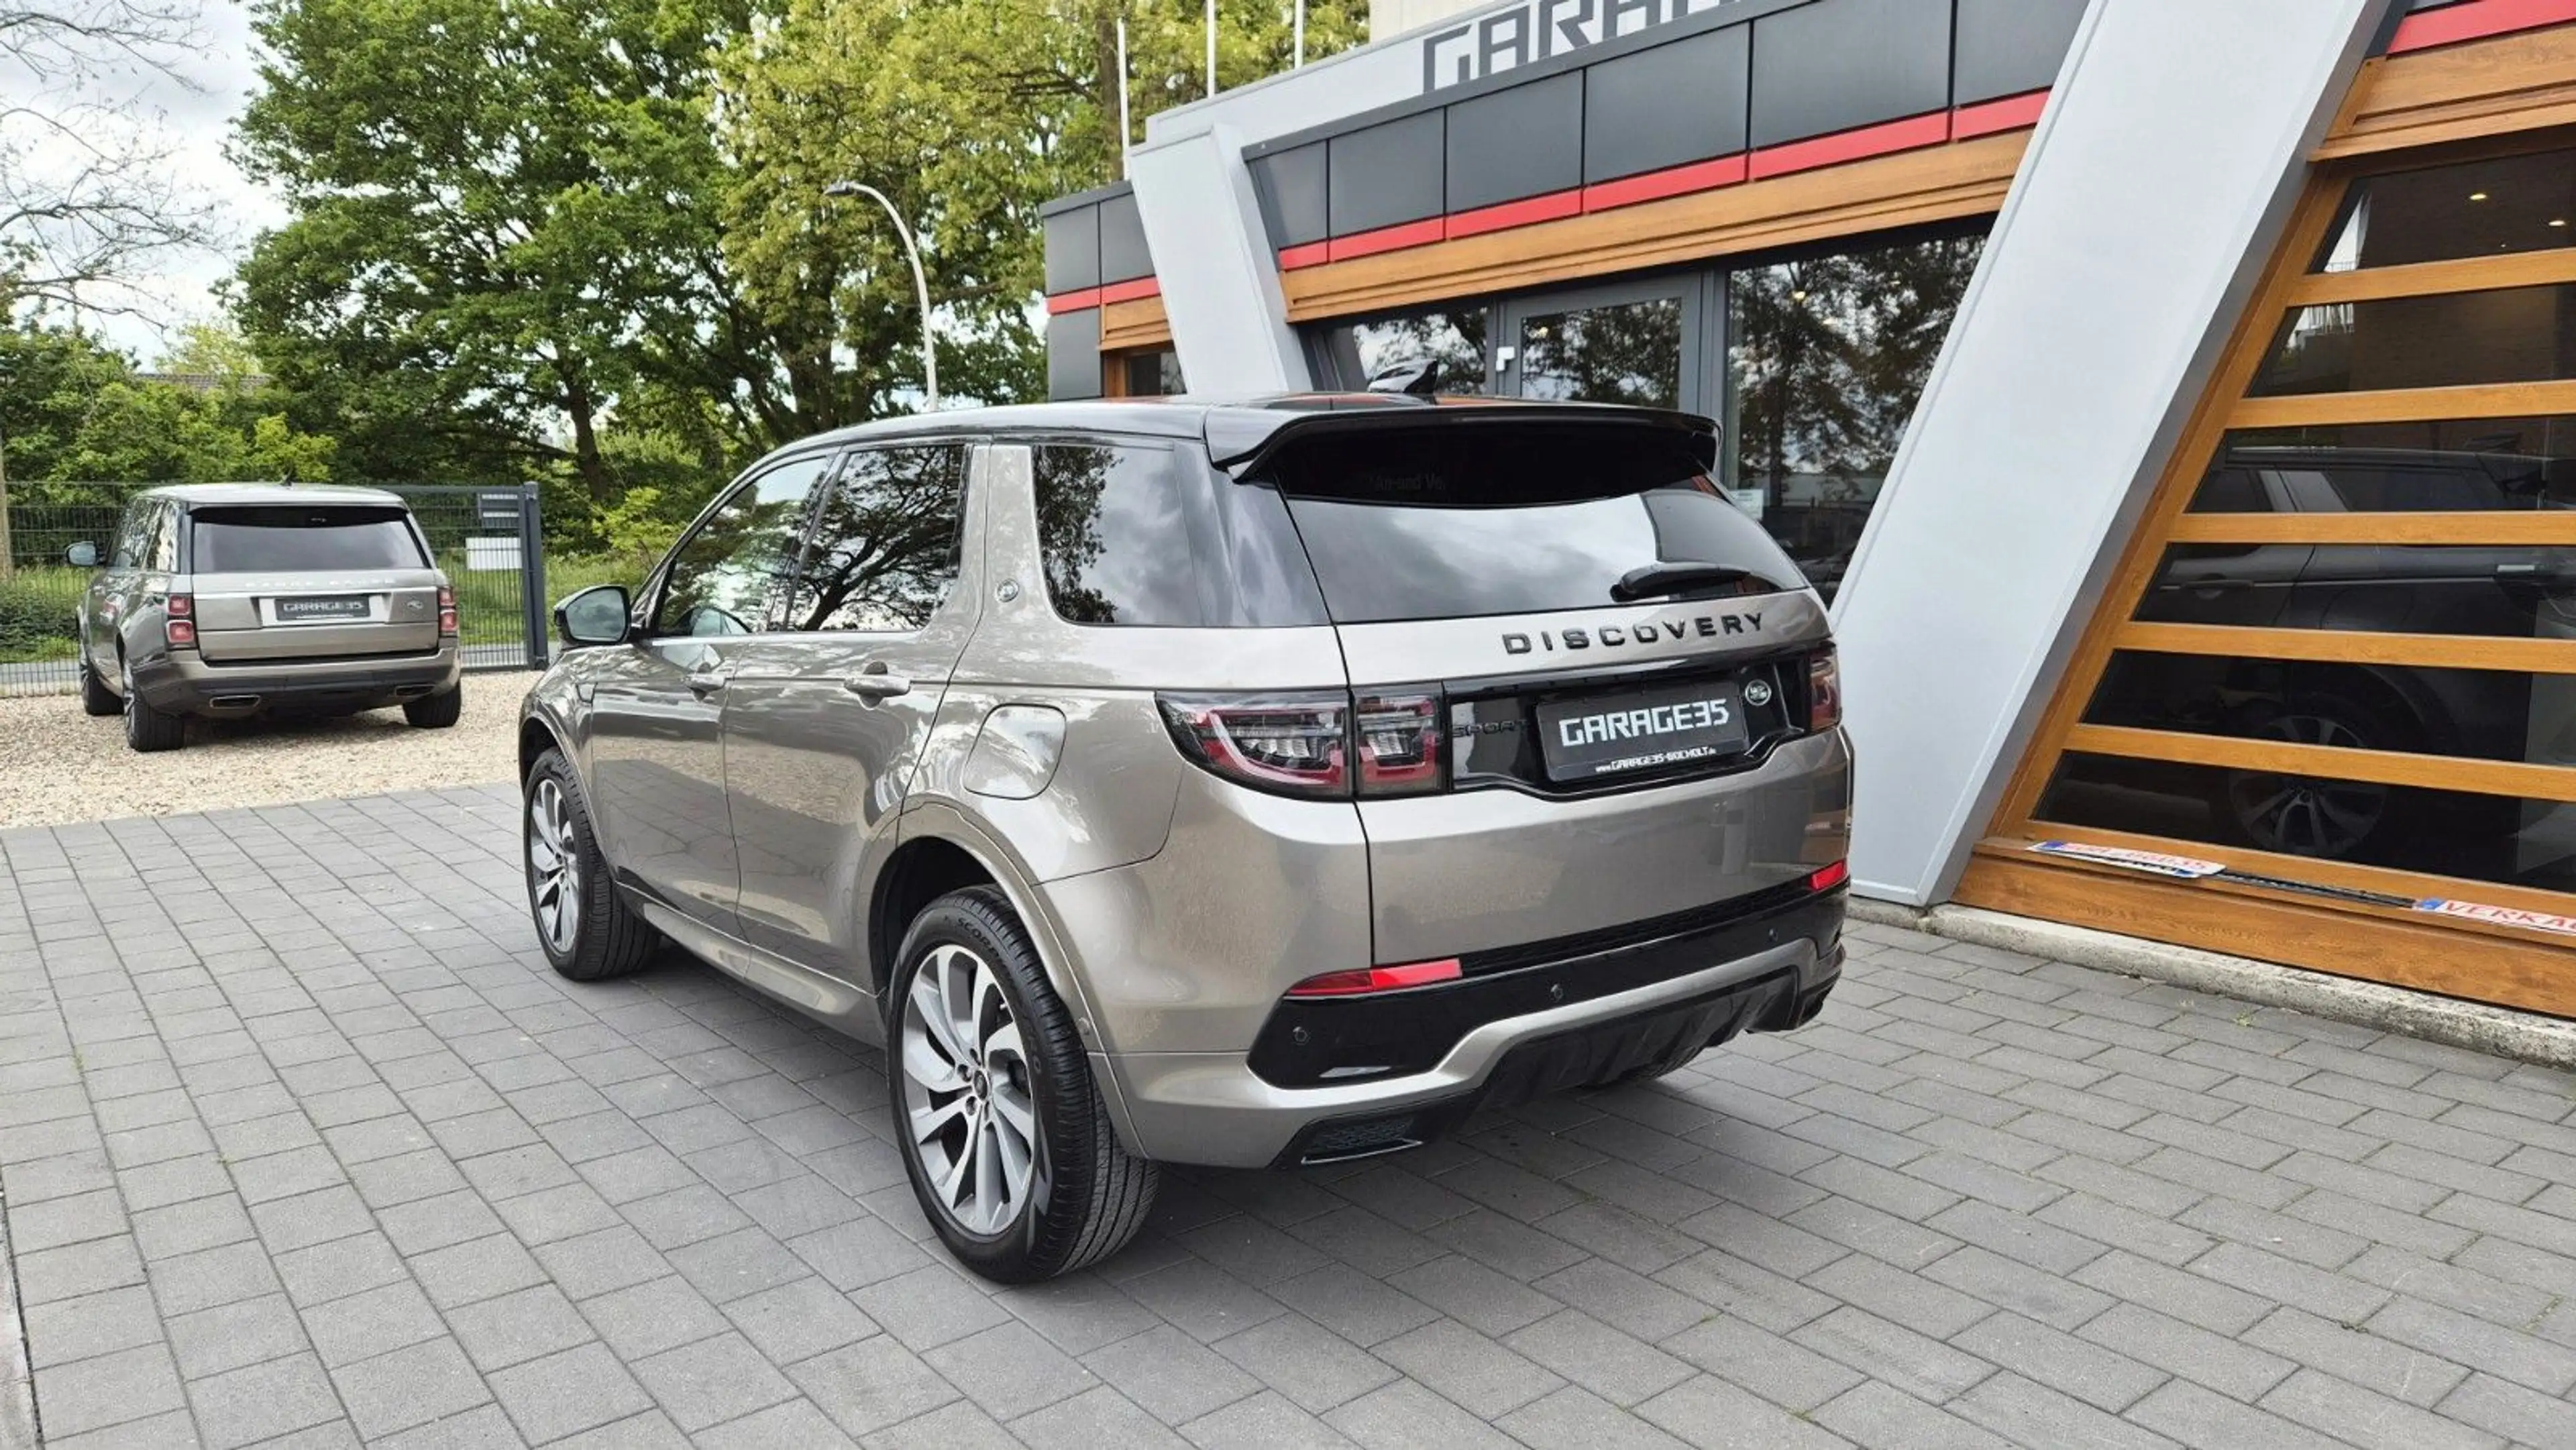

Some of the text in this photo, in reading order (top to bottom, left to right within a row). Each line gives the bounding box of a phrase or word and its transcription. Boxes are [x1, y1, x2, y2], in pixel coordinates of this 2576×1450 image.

[1424, 0, 1733, 93] GARA
[1502, 612, 1762, 655] DISCOVERY
[1450, 718, 1527, 737] SPORT
[1559, 700, 1729, 746] GARAGE35
